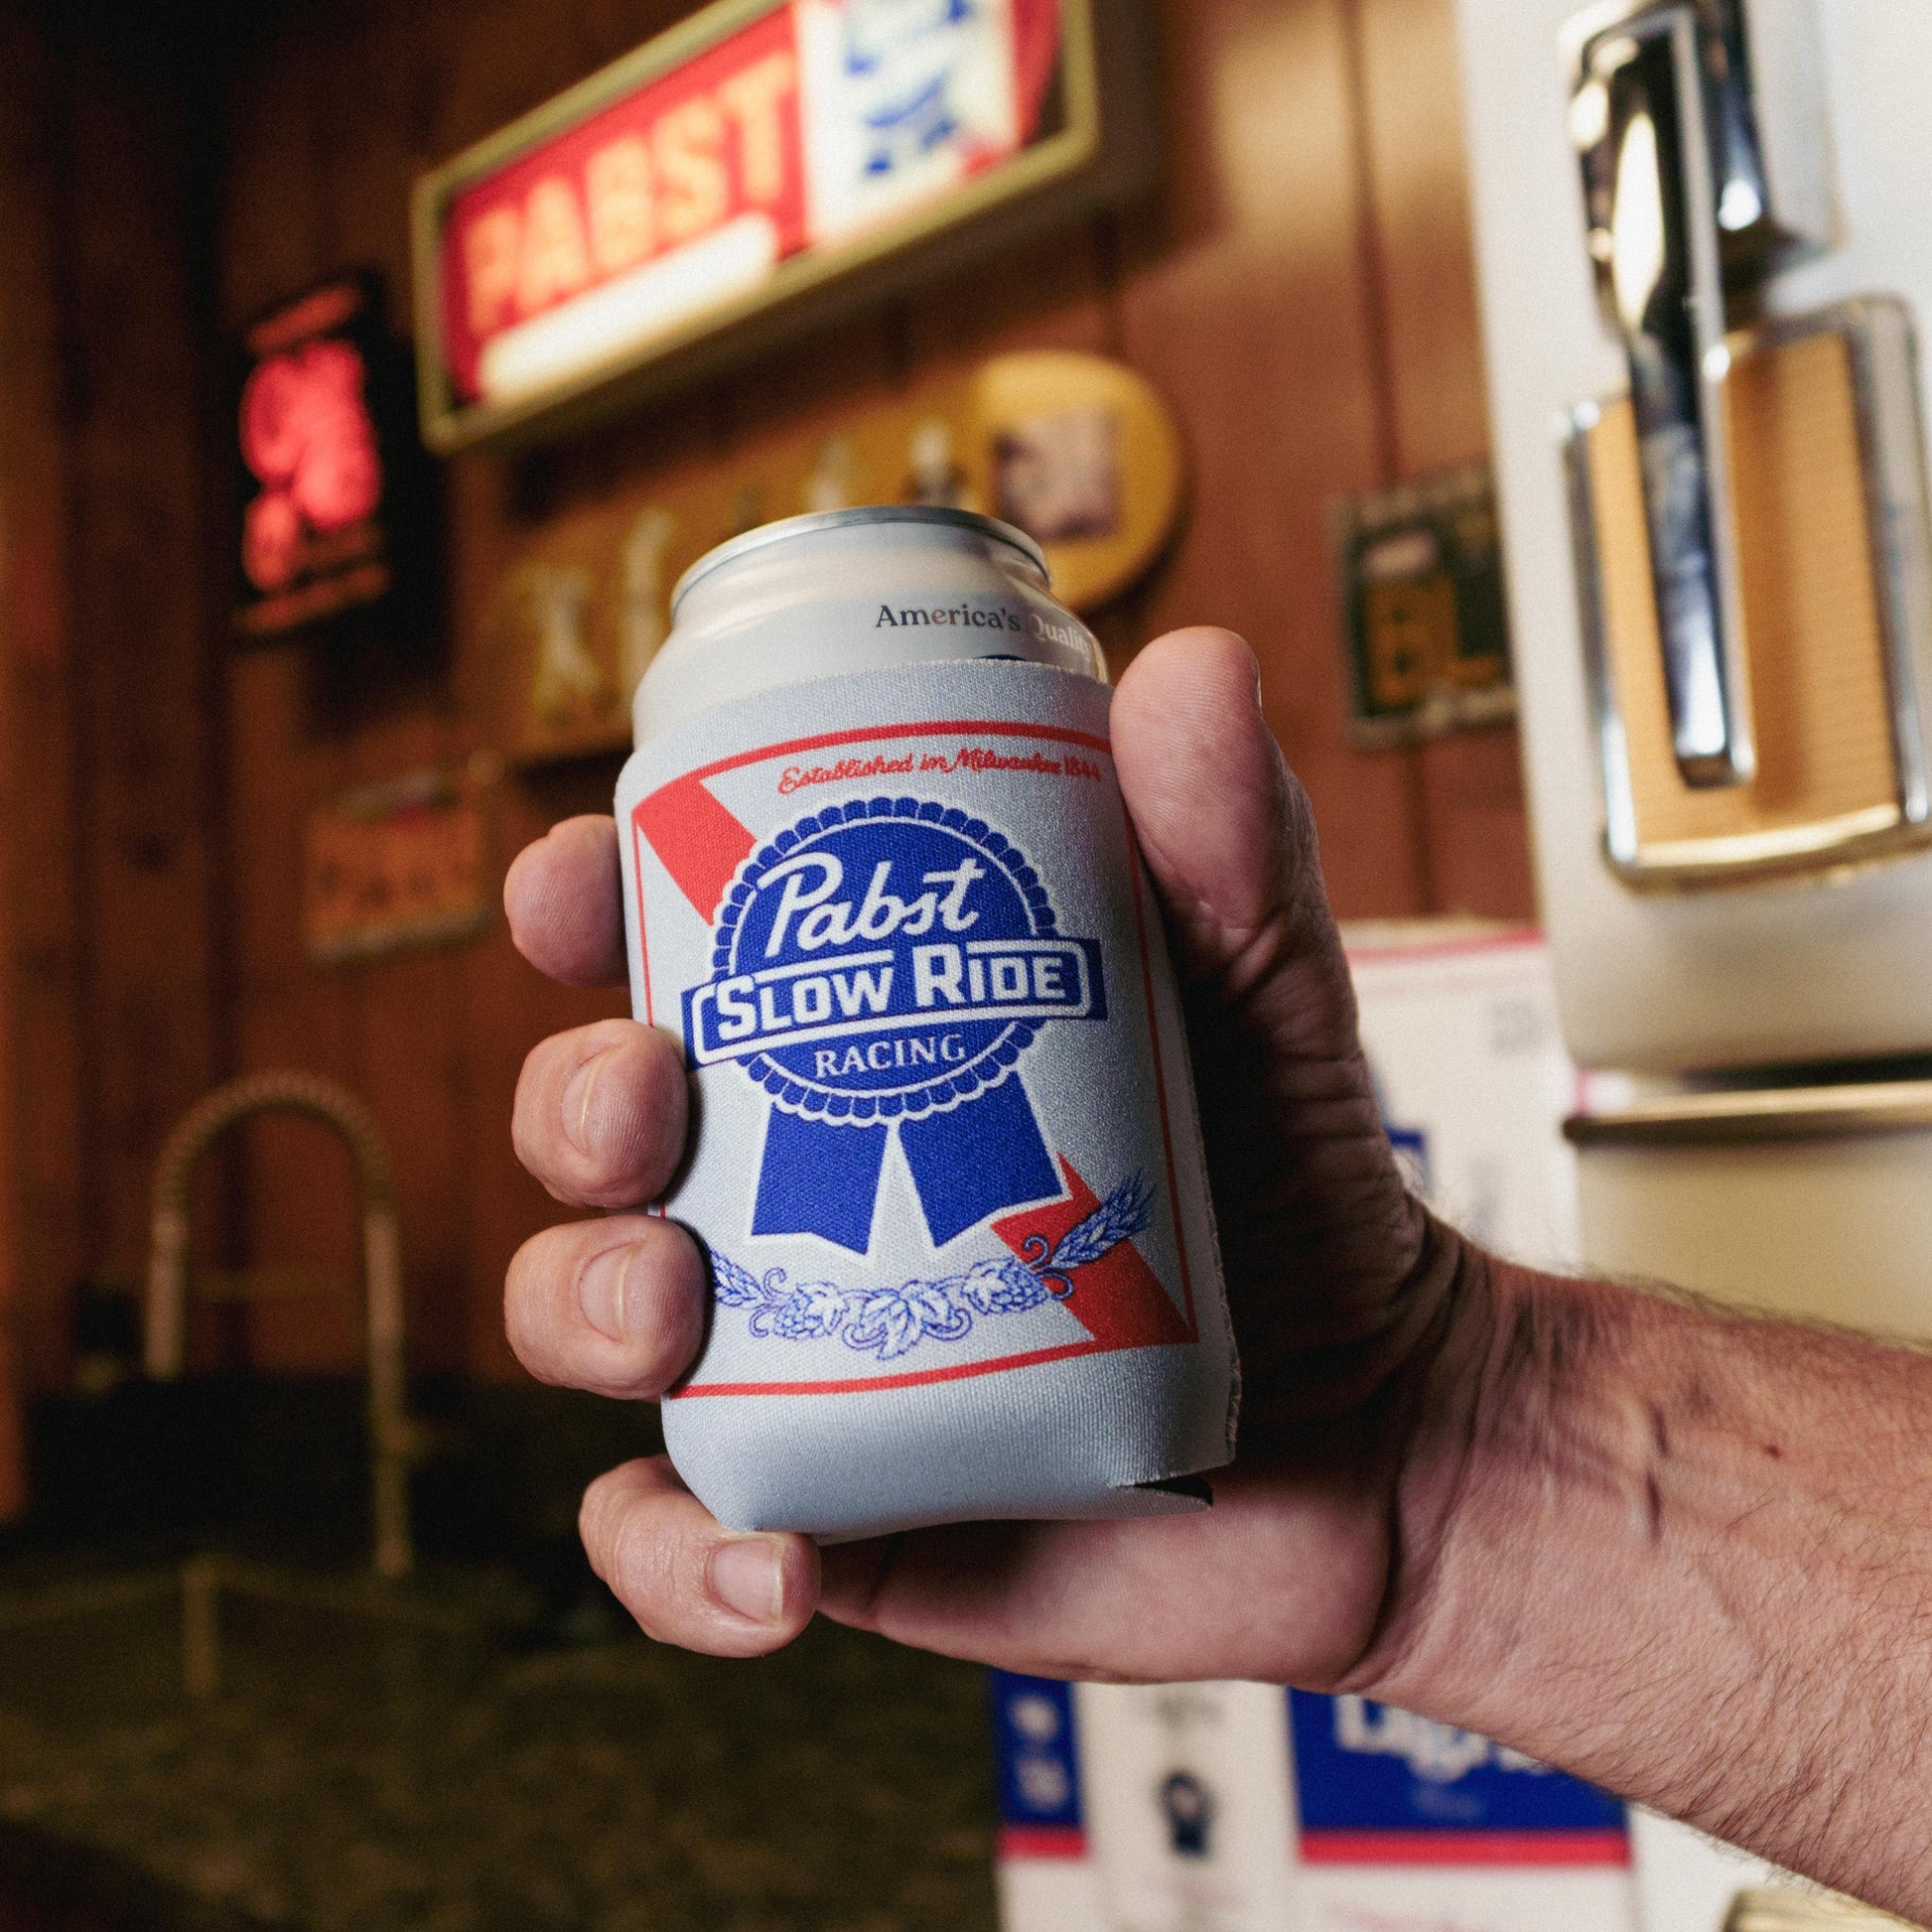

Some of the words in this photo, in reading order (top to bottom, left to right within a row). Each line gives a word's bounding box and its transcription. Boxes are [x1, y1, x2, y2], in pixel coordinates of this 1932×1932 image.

[463, 45, 794, 338] PABST
[875, 604, 1021, 631] America's
[777, 753, 914, 795] Established
[920, 753, 949, 773] in
[949, 747, 1060, 775] Milwaukee
[1063, 756, 1101, 782] 1844
[757, 851, 986, 958] Pabst
[716, 964, 893, 1041] SLOW
[814, 1034, 966, 1079] RACING
